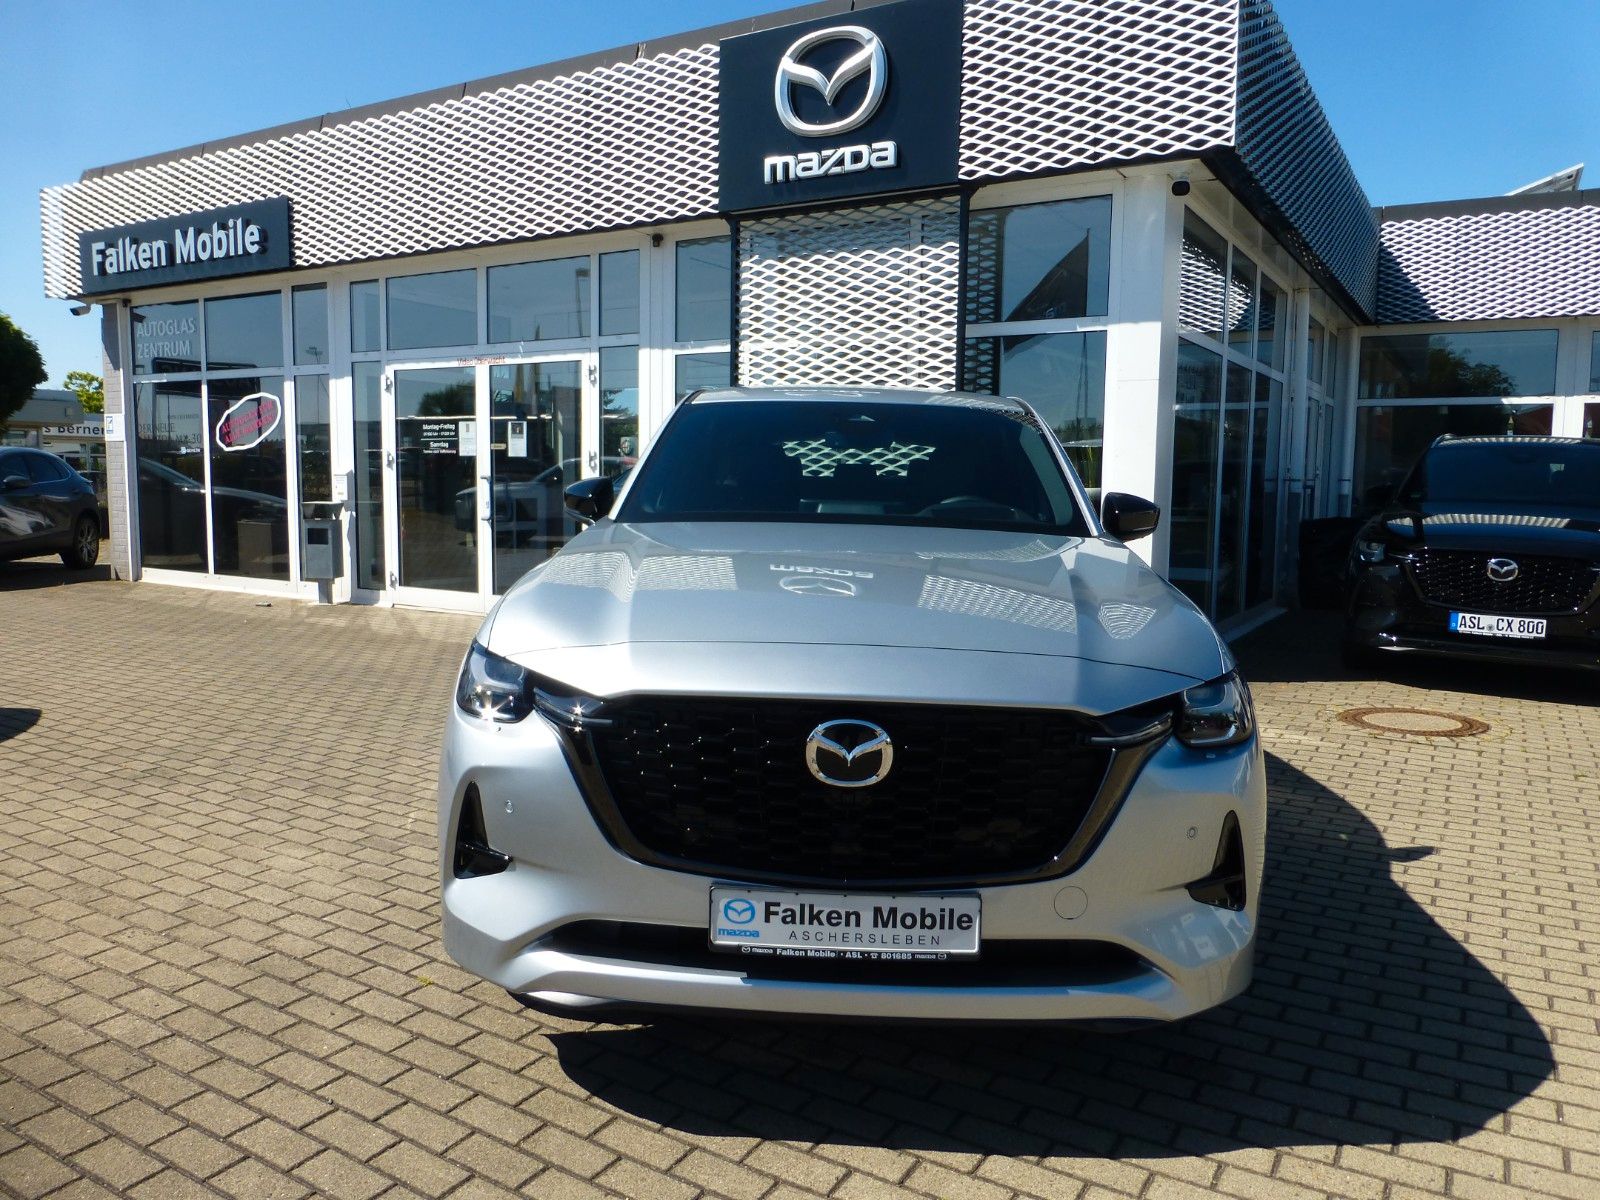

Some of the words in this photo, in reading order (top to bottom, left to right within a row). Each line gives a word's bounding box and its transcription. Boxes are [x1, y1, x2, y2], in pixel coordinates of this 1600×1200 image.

[764, 141, 897, 184] mazda
[91, 236, 168, 276] Falken
[174, 216, 261, 264] Mobile
[136, 318, 195, 337] AUTOGLAS
[136, 340, 190, 358] ZENTRUM
[1459, 615, 1484, 630] ASL
[1496, 618, 1513, 632] CX
[1518, 620, 1544, 635] 800
[763, 901, 862, 928] Falken
[872, 906, 974, 931] Mobile
[718, 927, 760, 938] mazda
[788, 930, 941, 946] ASCHERSLEBEN
[776, 948, 806, 957] Falken
[807, 949, 836, 958] Mobile
[845, 951, 863, 959] ASL
